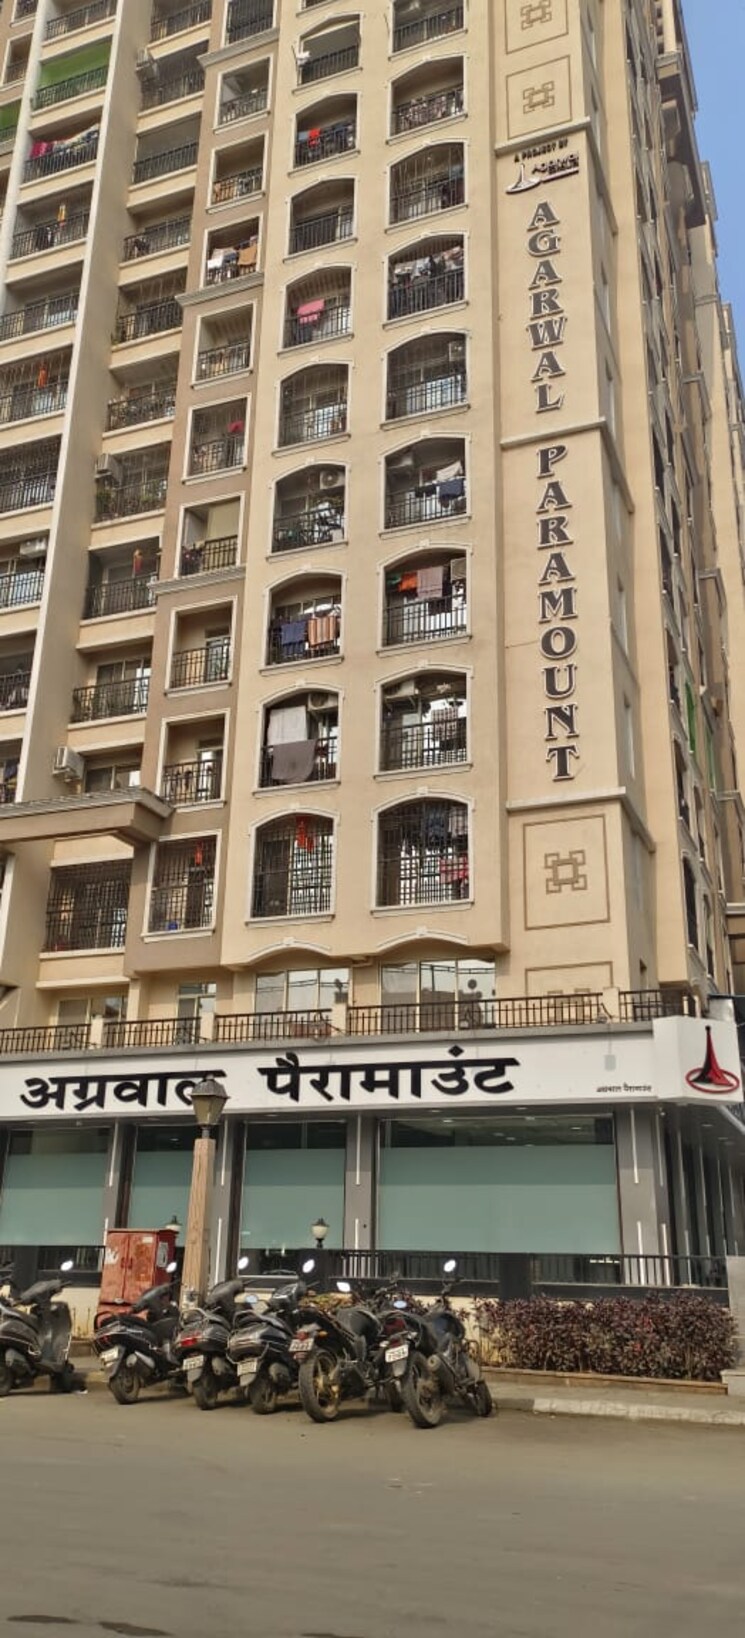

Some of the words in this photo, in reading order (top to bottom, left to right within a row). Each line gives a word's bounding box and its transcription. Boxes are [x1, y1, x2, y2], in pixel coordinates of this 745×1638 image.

[526, 201, 567, 414] AGARWAL
[536, 444, 579, 782] PARAMOUNT
[256, 1045, 520, 1102] पैरामाउंट
